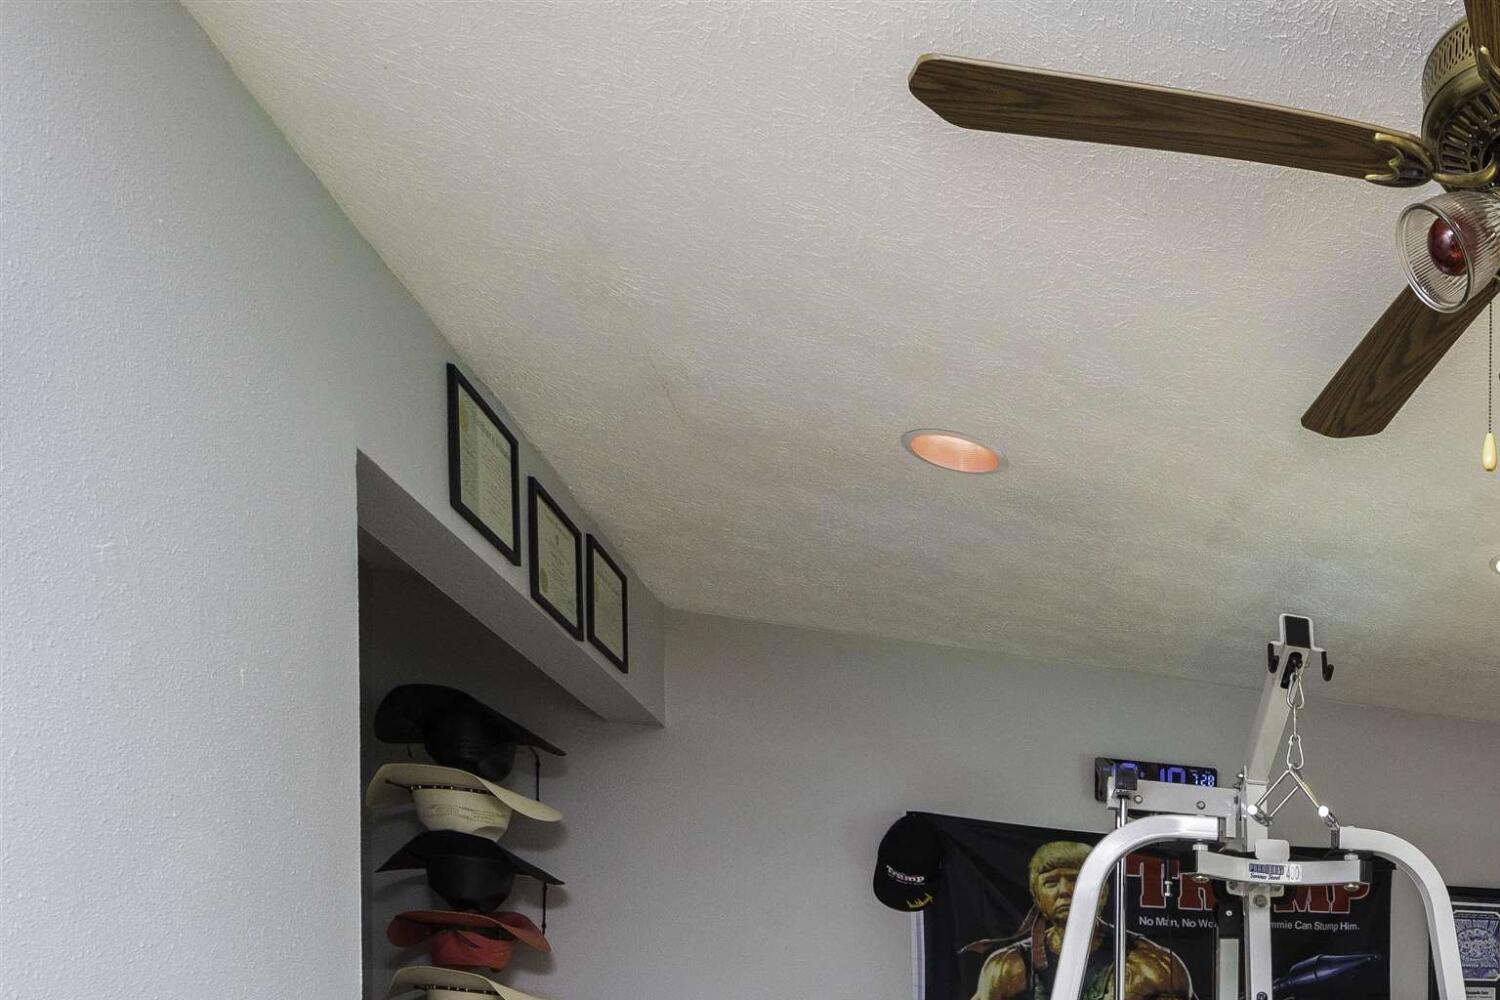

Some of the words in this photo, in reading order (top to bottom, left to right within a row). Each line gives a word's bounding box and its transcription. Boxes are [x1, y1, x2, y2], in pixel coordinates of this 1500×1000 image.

[1126, 853, 1370, 914] TRMP
[1139, 916, 1154, 926] No
[1182, 918, 1196, 928] No
[1295, 920, 1312, 930] Can
[1314, 921, 1338, 933] Stump
[1340, 922, 1360, 931] Him.
